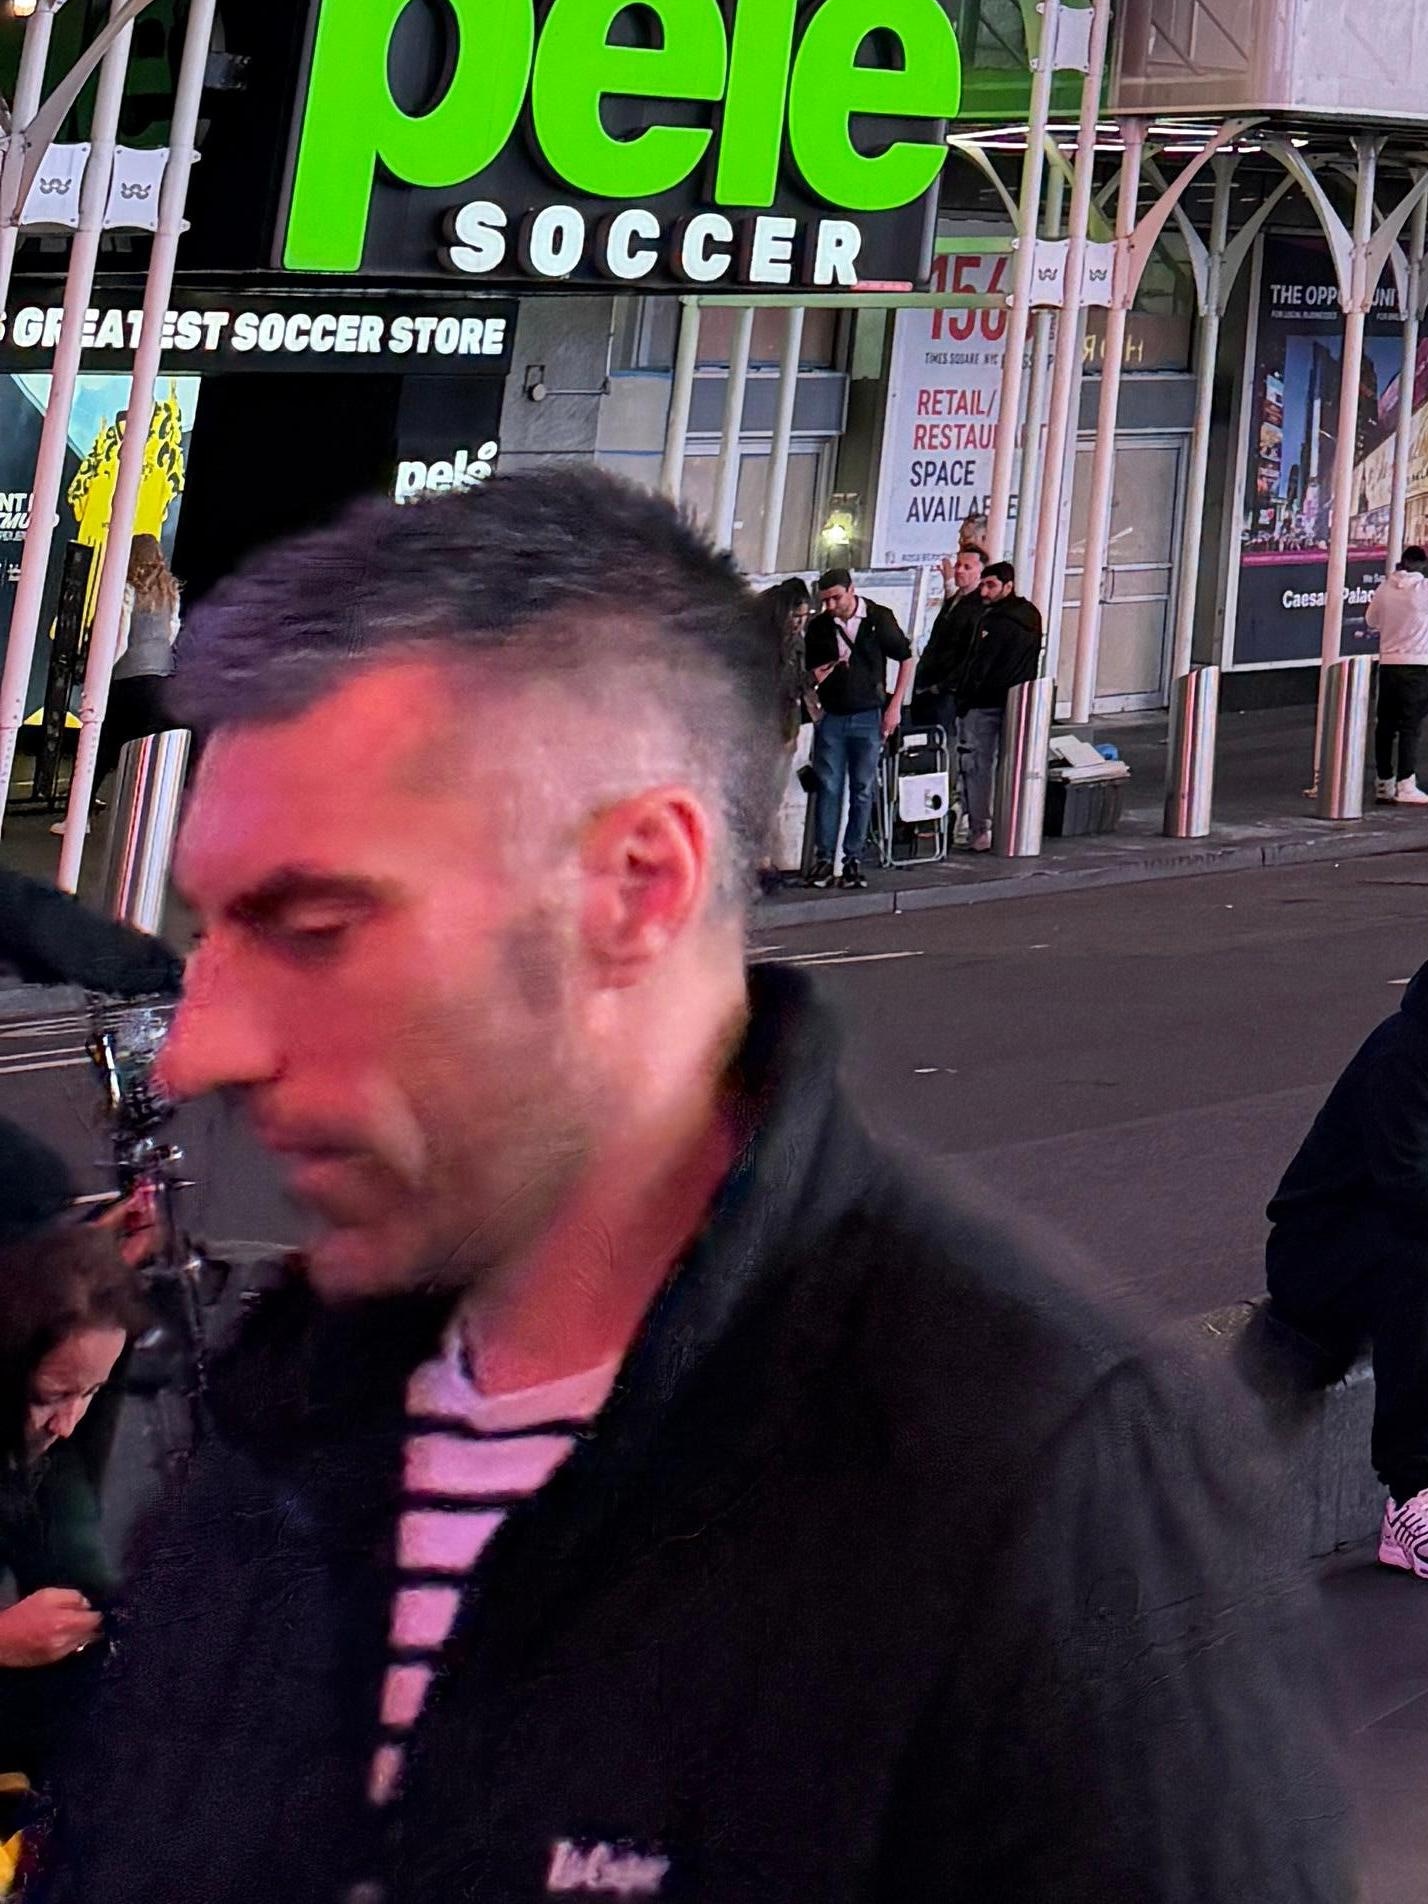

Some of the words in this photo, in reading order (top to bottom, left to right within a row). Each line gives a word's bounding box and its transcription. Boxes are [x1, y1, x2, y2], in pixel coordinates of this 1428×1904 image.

[450, 199, 861, 286] SOCCER
[1270, 284, 1303, 304] THE
[231, 312, 385, 354] SOCCER
[388, 316, 507, 355] STORE
[925, 352, 948, 365] TIMES
[950, 352, 979, 365] SQUARE
[917, 388, 996, 417] RETAIL/
[909, 459, 977, 488] SPACE
[1341, 586, 1376, 604] Palac
